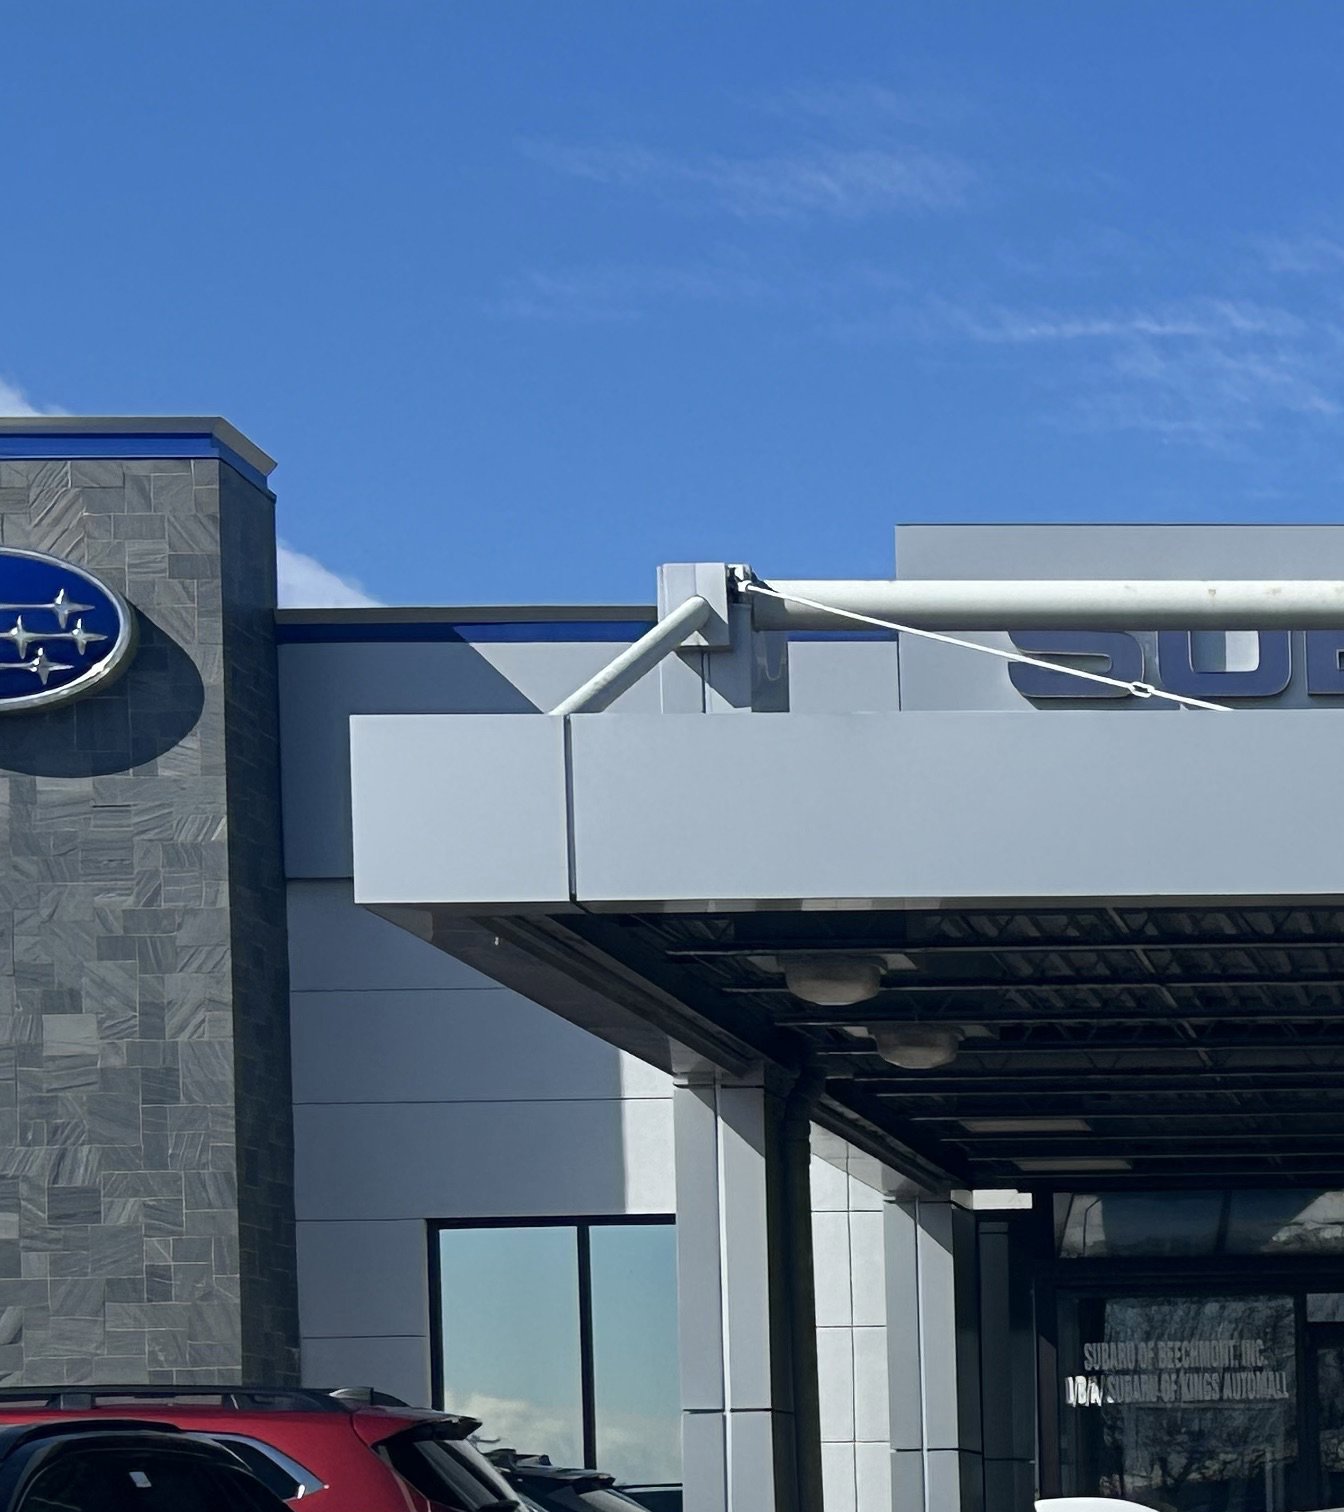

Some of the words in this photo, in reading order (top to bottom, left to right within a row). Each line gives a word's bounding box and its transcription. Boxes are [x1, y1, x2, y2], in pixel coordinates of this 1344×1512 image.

[1083, 1342, 1136, 1370] SUBARU
[1138, 1341, 1155, 1369] OF
[1106, 1374, 1158, 1403] SUBARU
[1160, 1372, 1177, 1402] OF
[1180, 1371, 1220, 1401] KINGS
[1222, 1371, 1289, 1400] AUTOMALL
